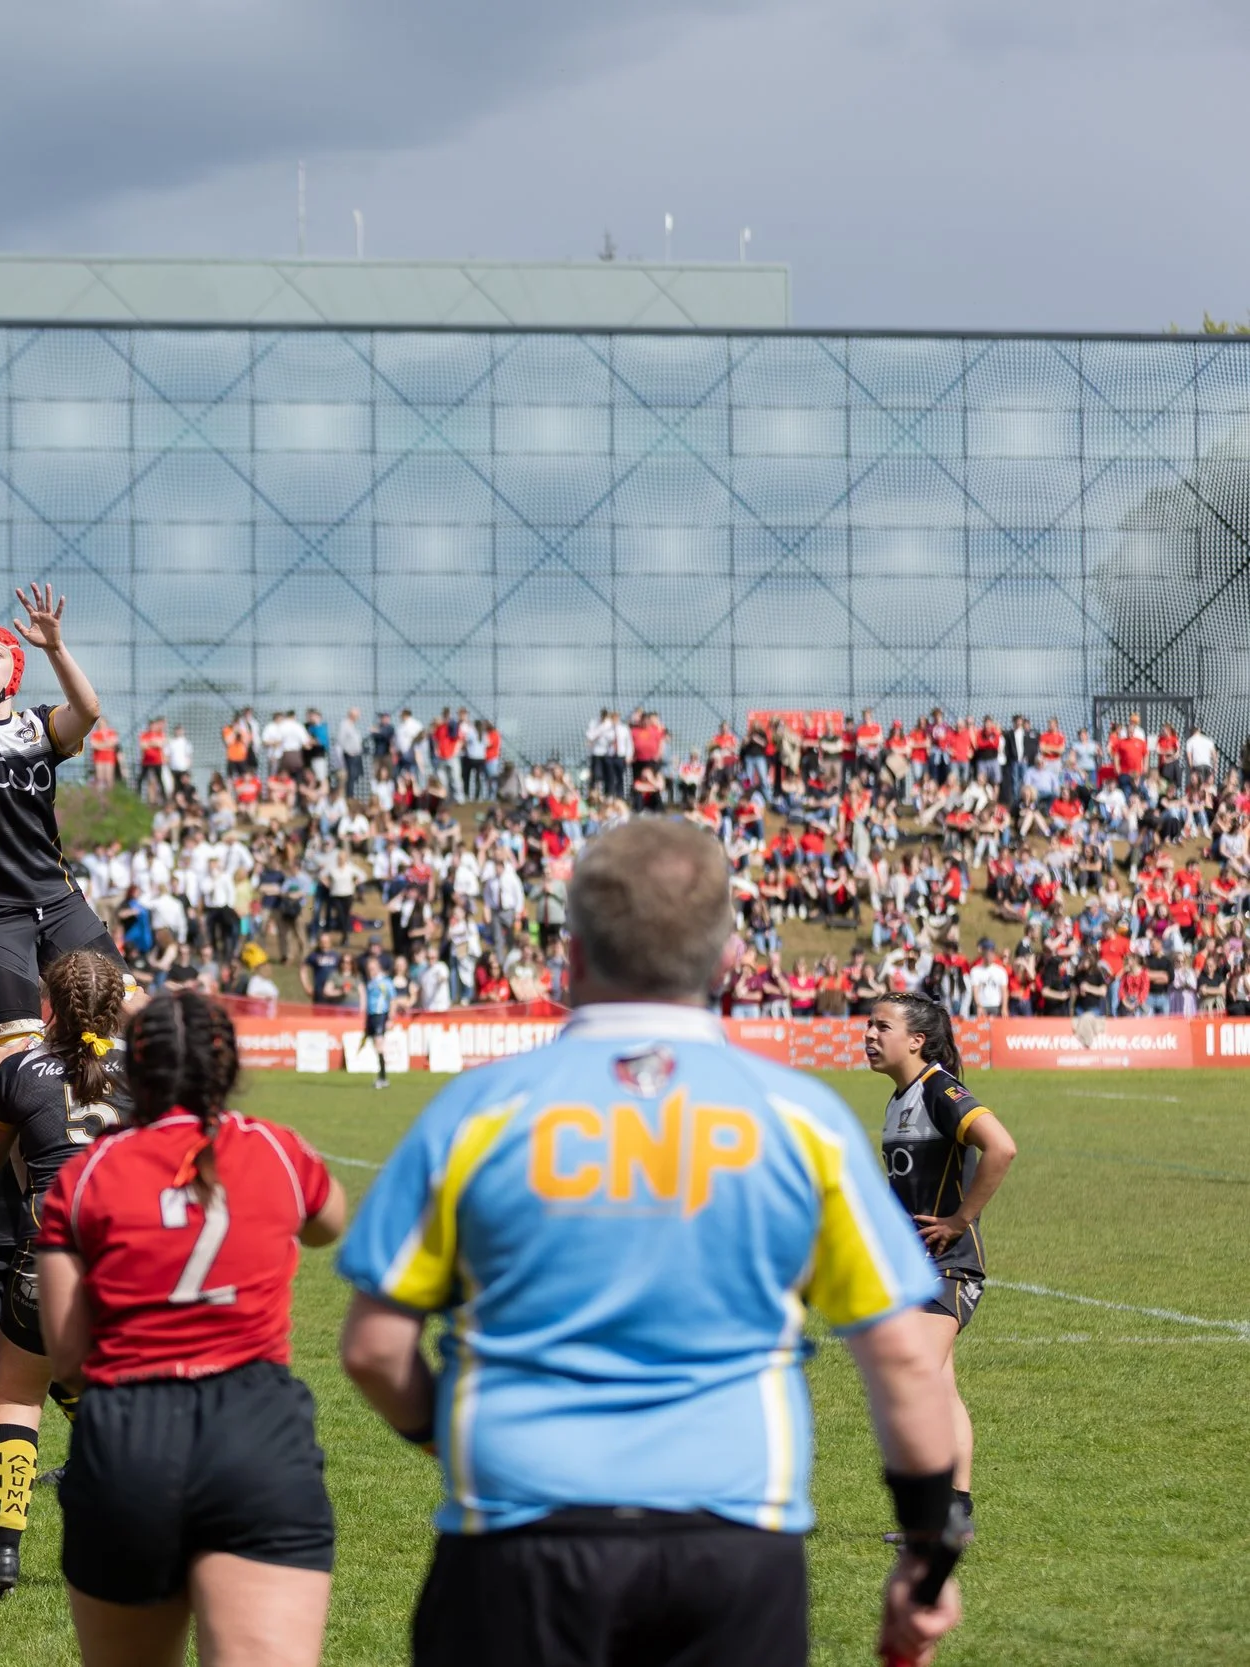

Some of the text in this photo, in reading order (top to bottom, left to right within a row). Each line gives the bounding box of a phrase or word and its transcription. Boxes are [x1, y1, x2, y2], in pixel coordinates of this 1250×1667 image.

[32, 1062, 64, 1078] The
[63, 1082, 122, 1145] 5
[530, 1086, 763, 1221] CNP
[160, 1183, 237, 1304] 2
[4, 1454, 31, 1515] AKUMA
